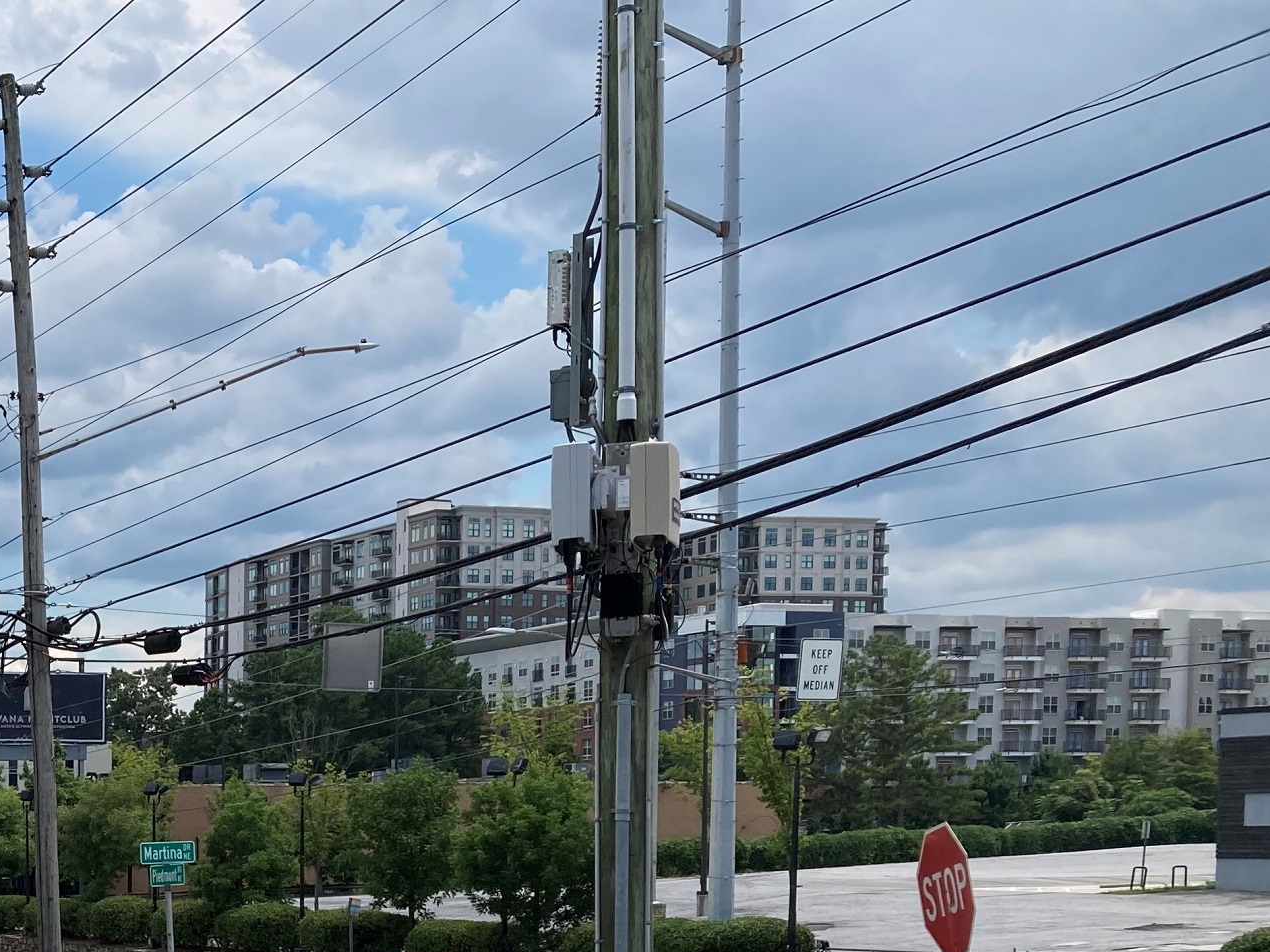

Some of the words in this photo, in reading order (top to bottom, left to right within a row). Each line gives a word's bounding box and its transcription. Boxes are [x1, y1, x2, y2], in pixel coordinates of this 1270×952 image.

[811, 648, 833, 659] KEEP
[812, 664, 829, 675] OFF
[803, 680, 835, 691] MEDIAN
[144, 846, 182, 860] Martina
[183, 852, 191, 860] NE
[152, 868, 178, 883] Piedmont
[922, 862, 967, 922] STOP
